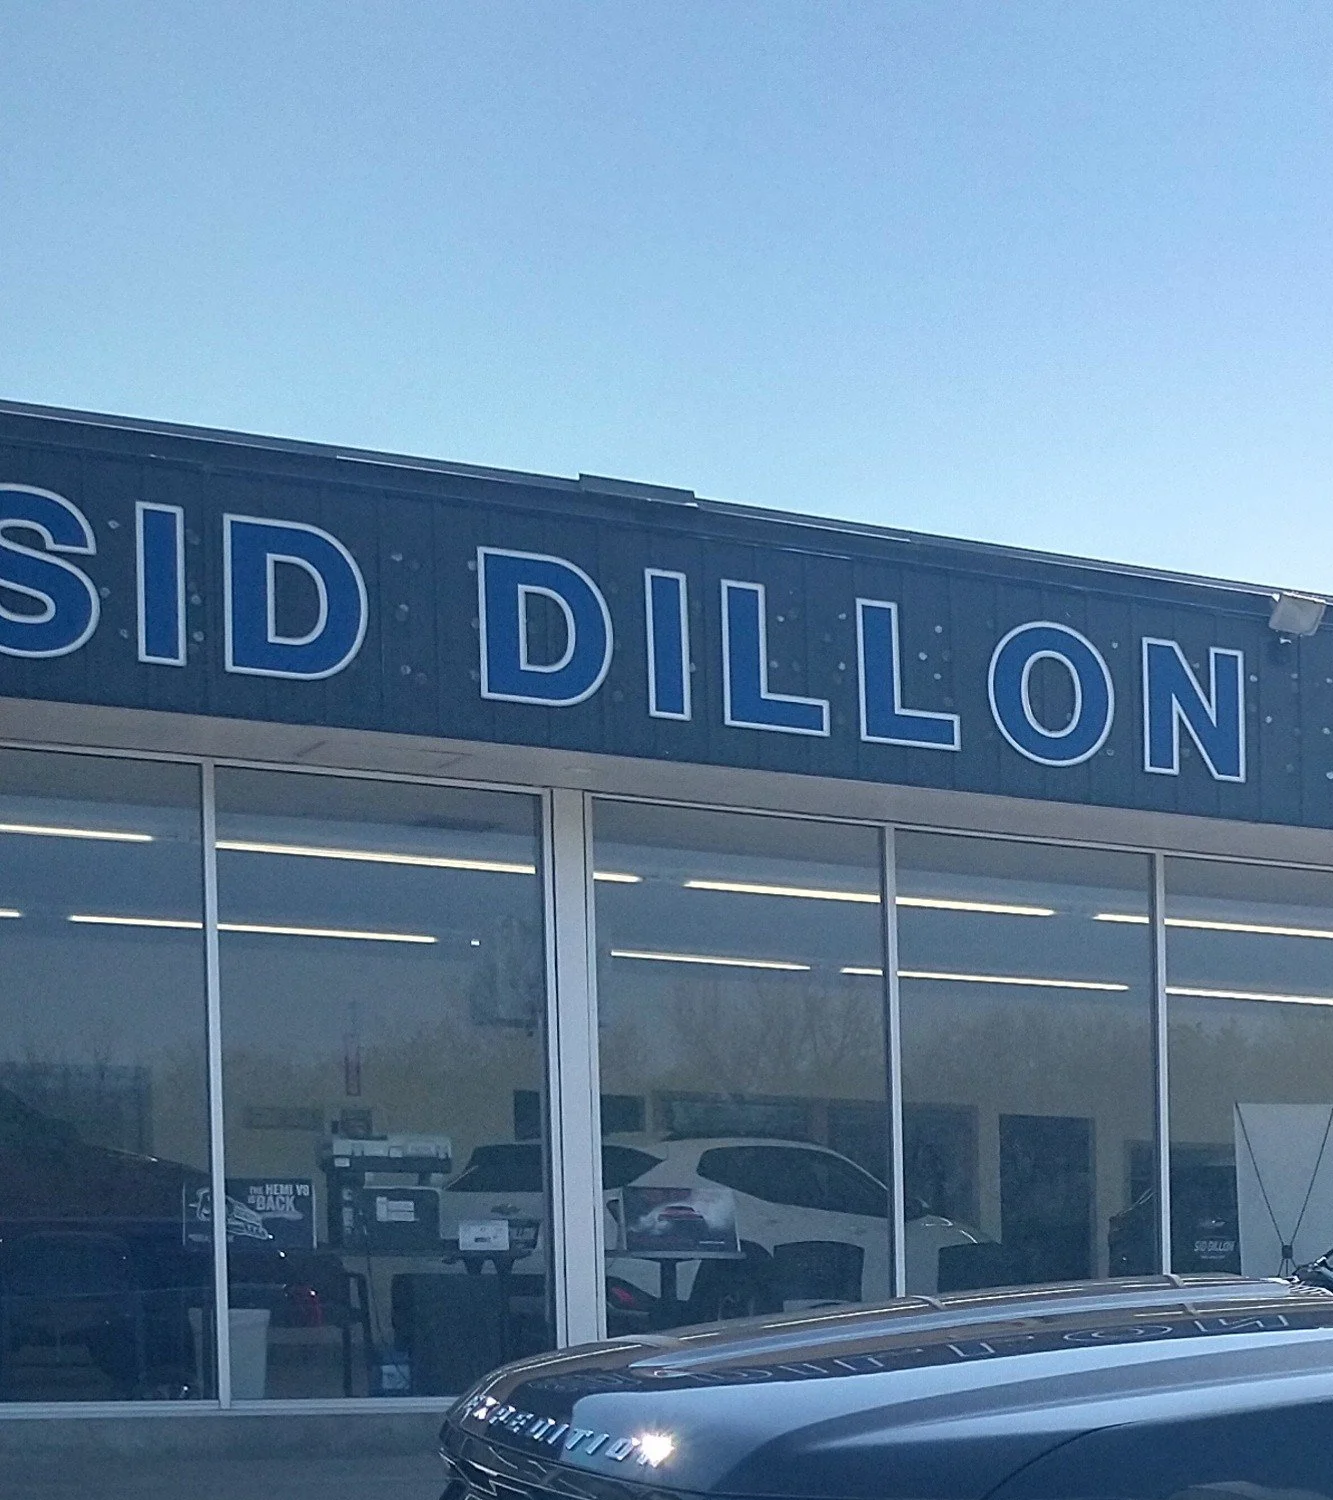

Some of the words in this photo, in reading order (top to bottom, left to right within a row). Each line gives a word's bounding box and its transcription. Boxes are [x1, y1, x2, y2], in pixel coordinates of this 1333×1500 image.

[0, 482, 369, 681] SID
[477, 546, 1247, 784] DILLON
[265, 1184, 293, 1195] HEMI
[256, 1195, 296, 1212] BACK
